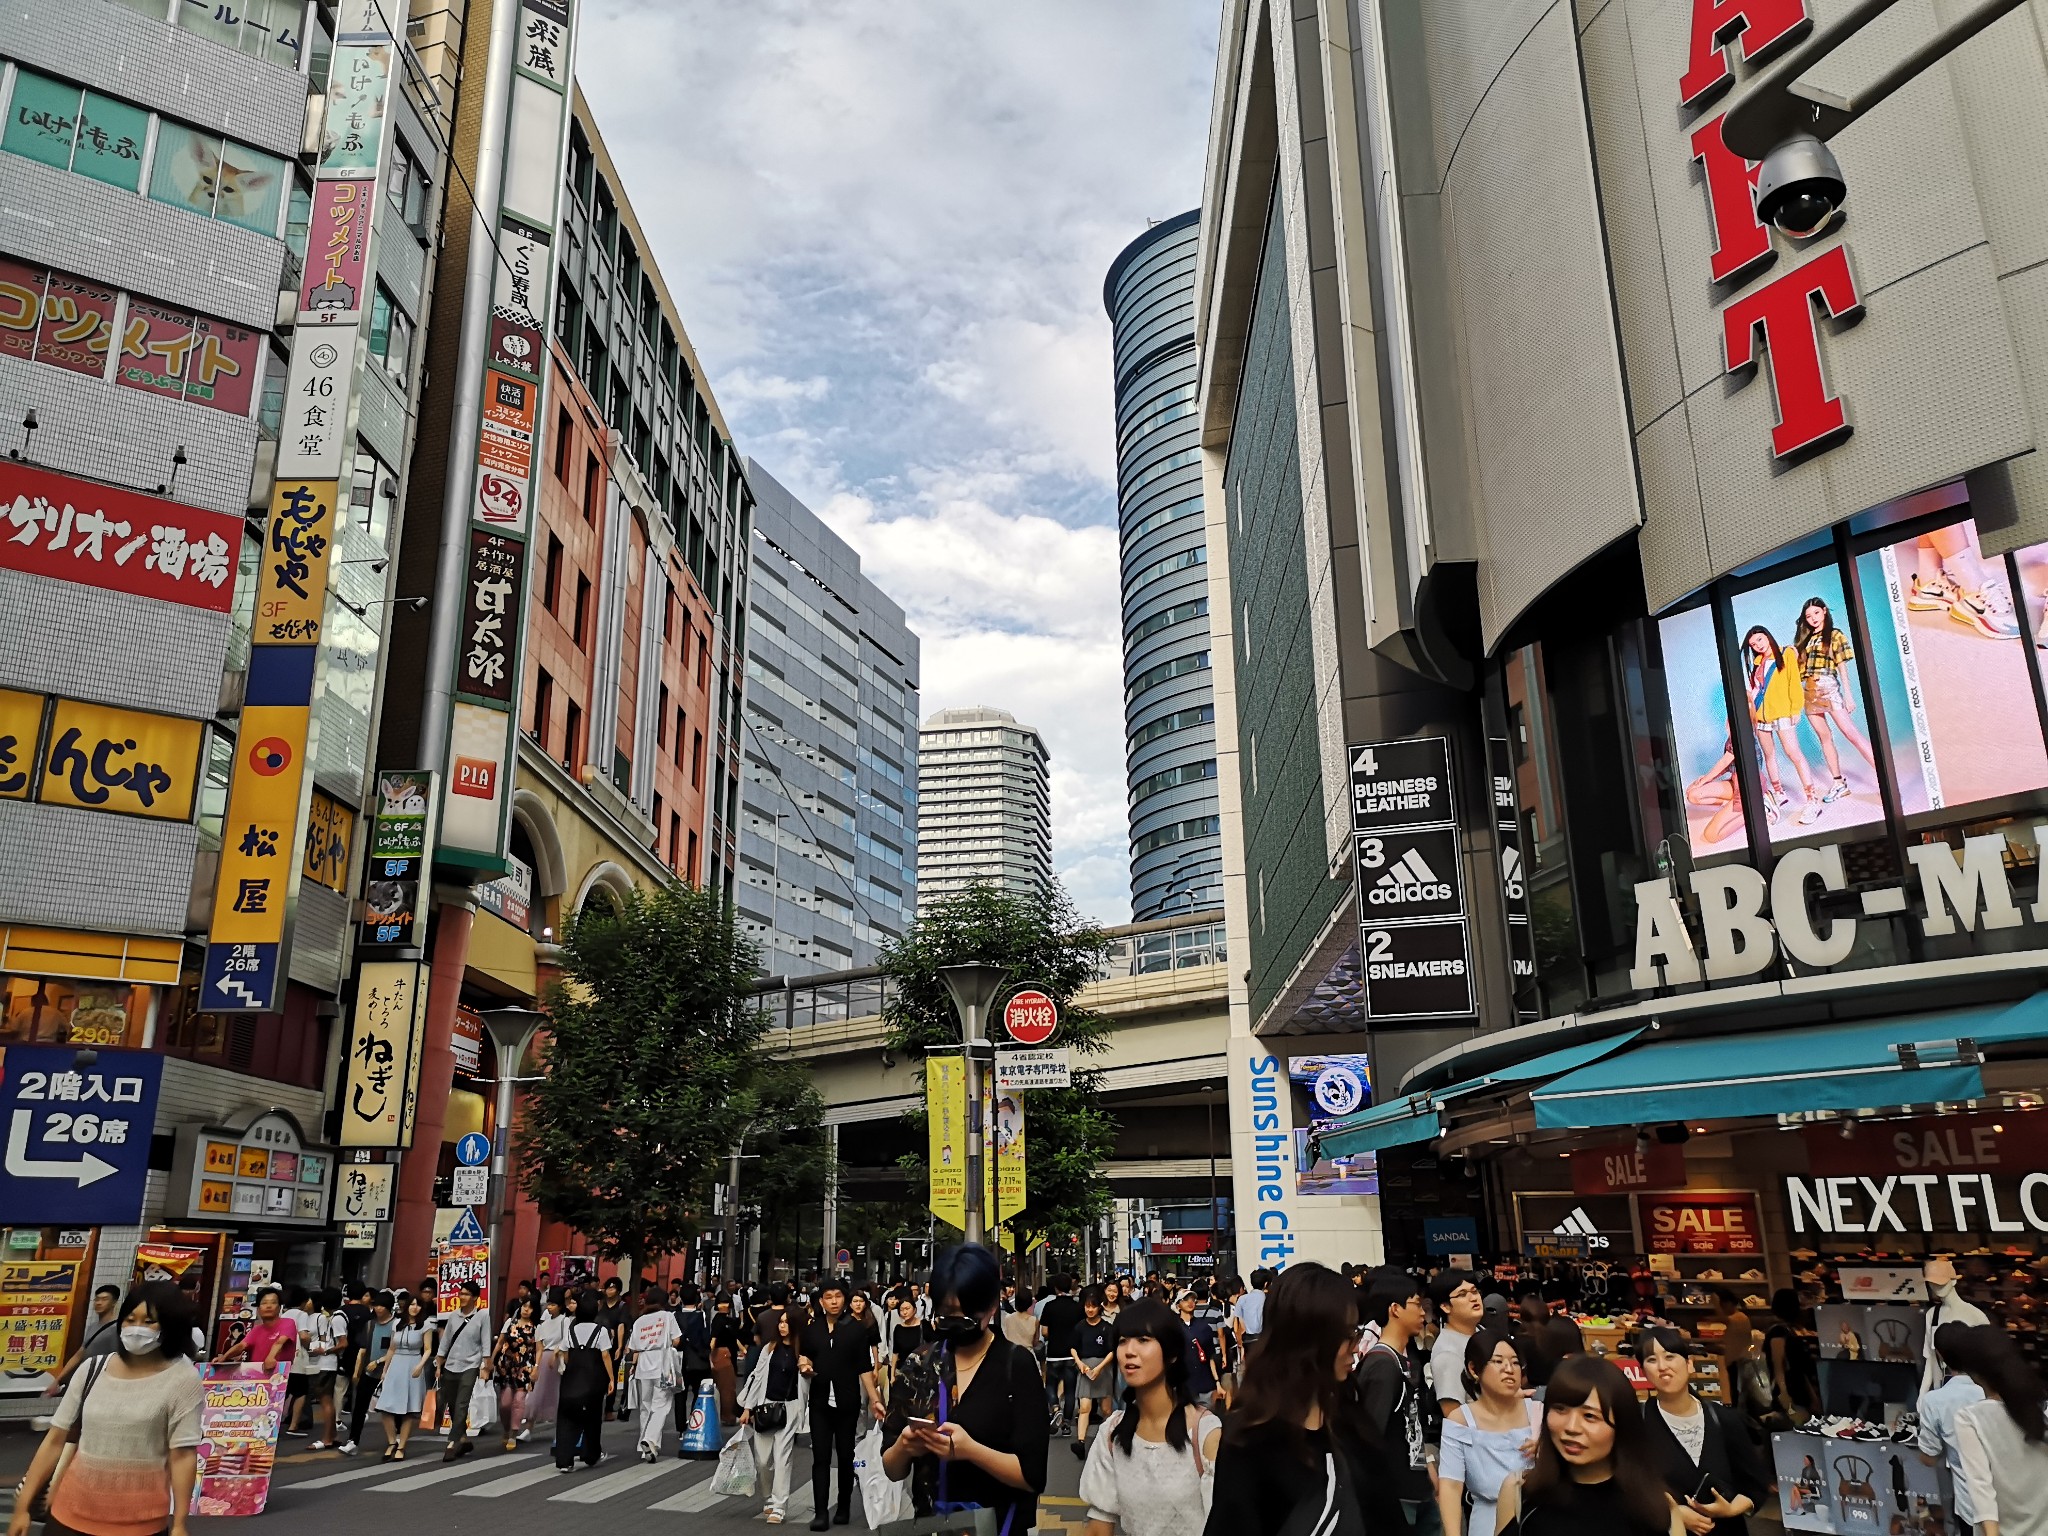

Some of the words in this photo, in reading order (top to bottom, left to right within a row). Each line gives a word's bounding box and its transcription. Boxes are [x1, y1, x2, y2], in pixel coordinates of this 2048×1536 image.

[340, 169, 357, 177] 6F
[325, 184, 356, 291] コツメイト
[321, 313, 337, 323] 5F
[500, 384, 521, 397] 快活
[500, 394, 521, 405] CLUB
[485, 409, 532, 428] インターネット
[496, 405, 523, 419] コミック
[491, 447, 519, 459] シャワー
[487, 536, 505, 547] 4F
[478, 547, 515, 564] 手作り
[475, 560, 514, 579] 居酒屋
[262, 602, 288, 617] 3F
[467, 576, 512, 687] 甘太郎
[1353, 749, 1378, 776] 4
[460, 764, 489, 786] PIA
[1355, 777, 1437, 798] BUSINESS
[1355, 793, 1430, 814] LEATHER
[394, 822, 409, 832] 6F
[1359, 838, 1385, 868] 3
[233, 824, 278, 914] 松屋
[385, 860, 409, 876] 5F
[1369, 882, 1452, 905] adidas
[1629, 825, 2048, 990] ABC-M
[366, 913, 414, 925] コツメイト
[376, 926, 402, 942] 5F
[232, 944, 256, 958] 2階
[1367, 931, 1393, 962] 2
[225, 958, 260, 972] 26席
[1369, 960, 1465, 979] SNEAKERS
[1010, 1007, 1052, 1027] 消火栓
[353, 1031, 394, 1122] ねぎし
[1000, 1063, 1067, 1076] 東京電子専門学校
[17, 1072, 143, 1102] 2階入口
[43, 1112, 129, 1144] 26席
[1250, 1055, 1289, 1202] Sunshine
[1893, 1126, 2000, 1168] SALE
[1604, 1152, 1648, 1187] SALE
[346, 1169, 367, 1216] ねぎし
[1652, 1207, 1746, 1232] SALE
[1432, 1231, 1470, 1242] SANDAL
[1653, 1239, 1677, 1249] sale
[1693, 1240, 1713, 1250] sale
[1730, 1238, 1754, 1249] sale
[449, 1260, 487, 1280] 焼肉
[7, 1334, 49, 1352] 無料
[1778, 1475, 1827, 1487] STANDARD
[1834, 1495, 1884, 1507] STANDARD
[1852, 1510, 1868, 1520] 996
